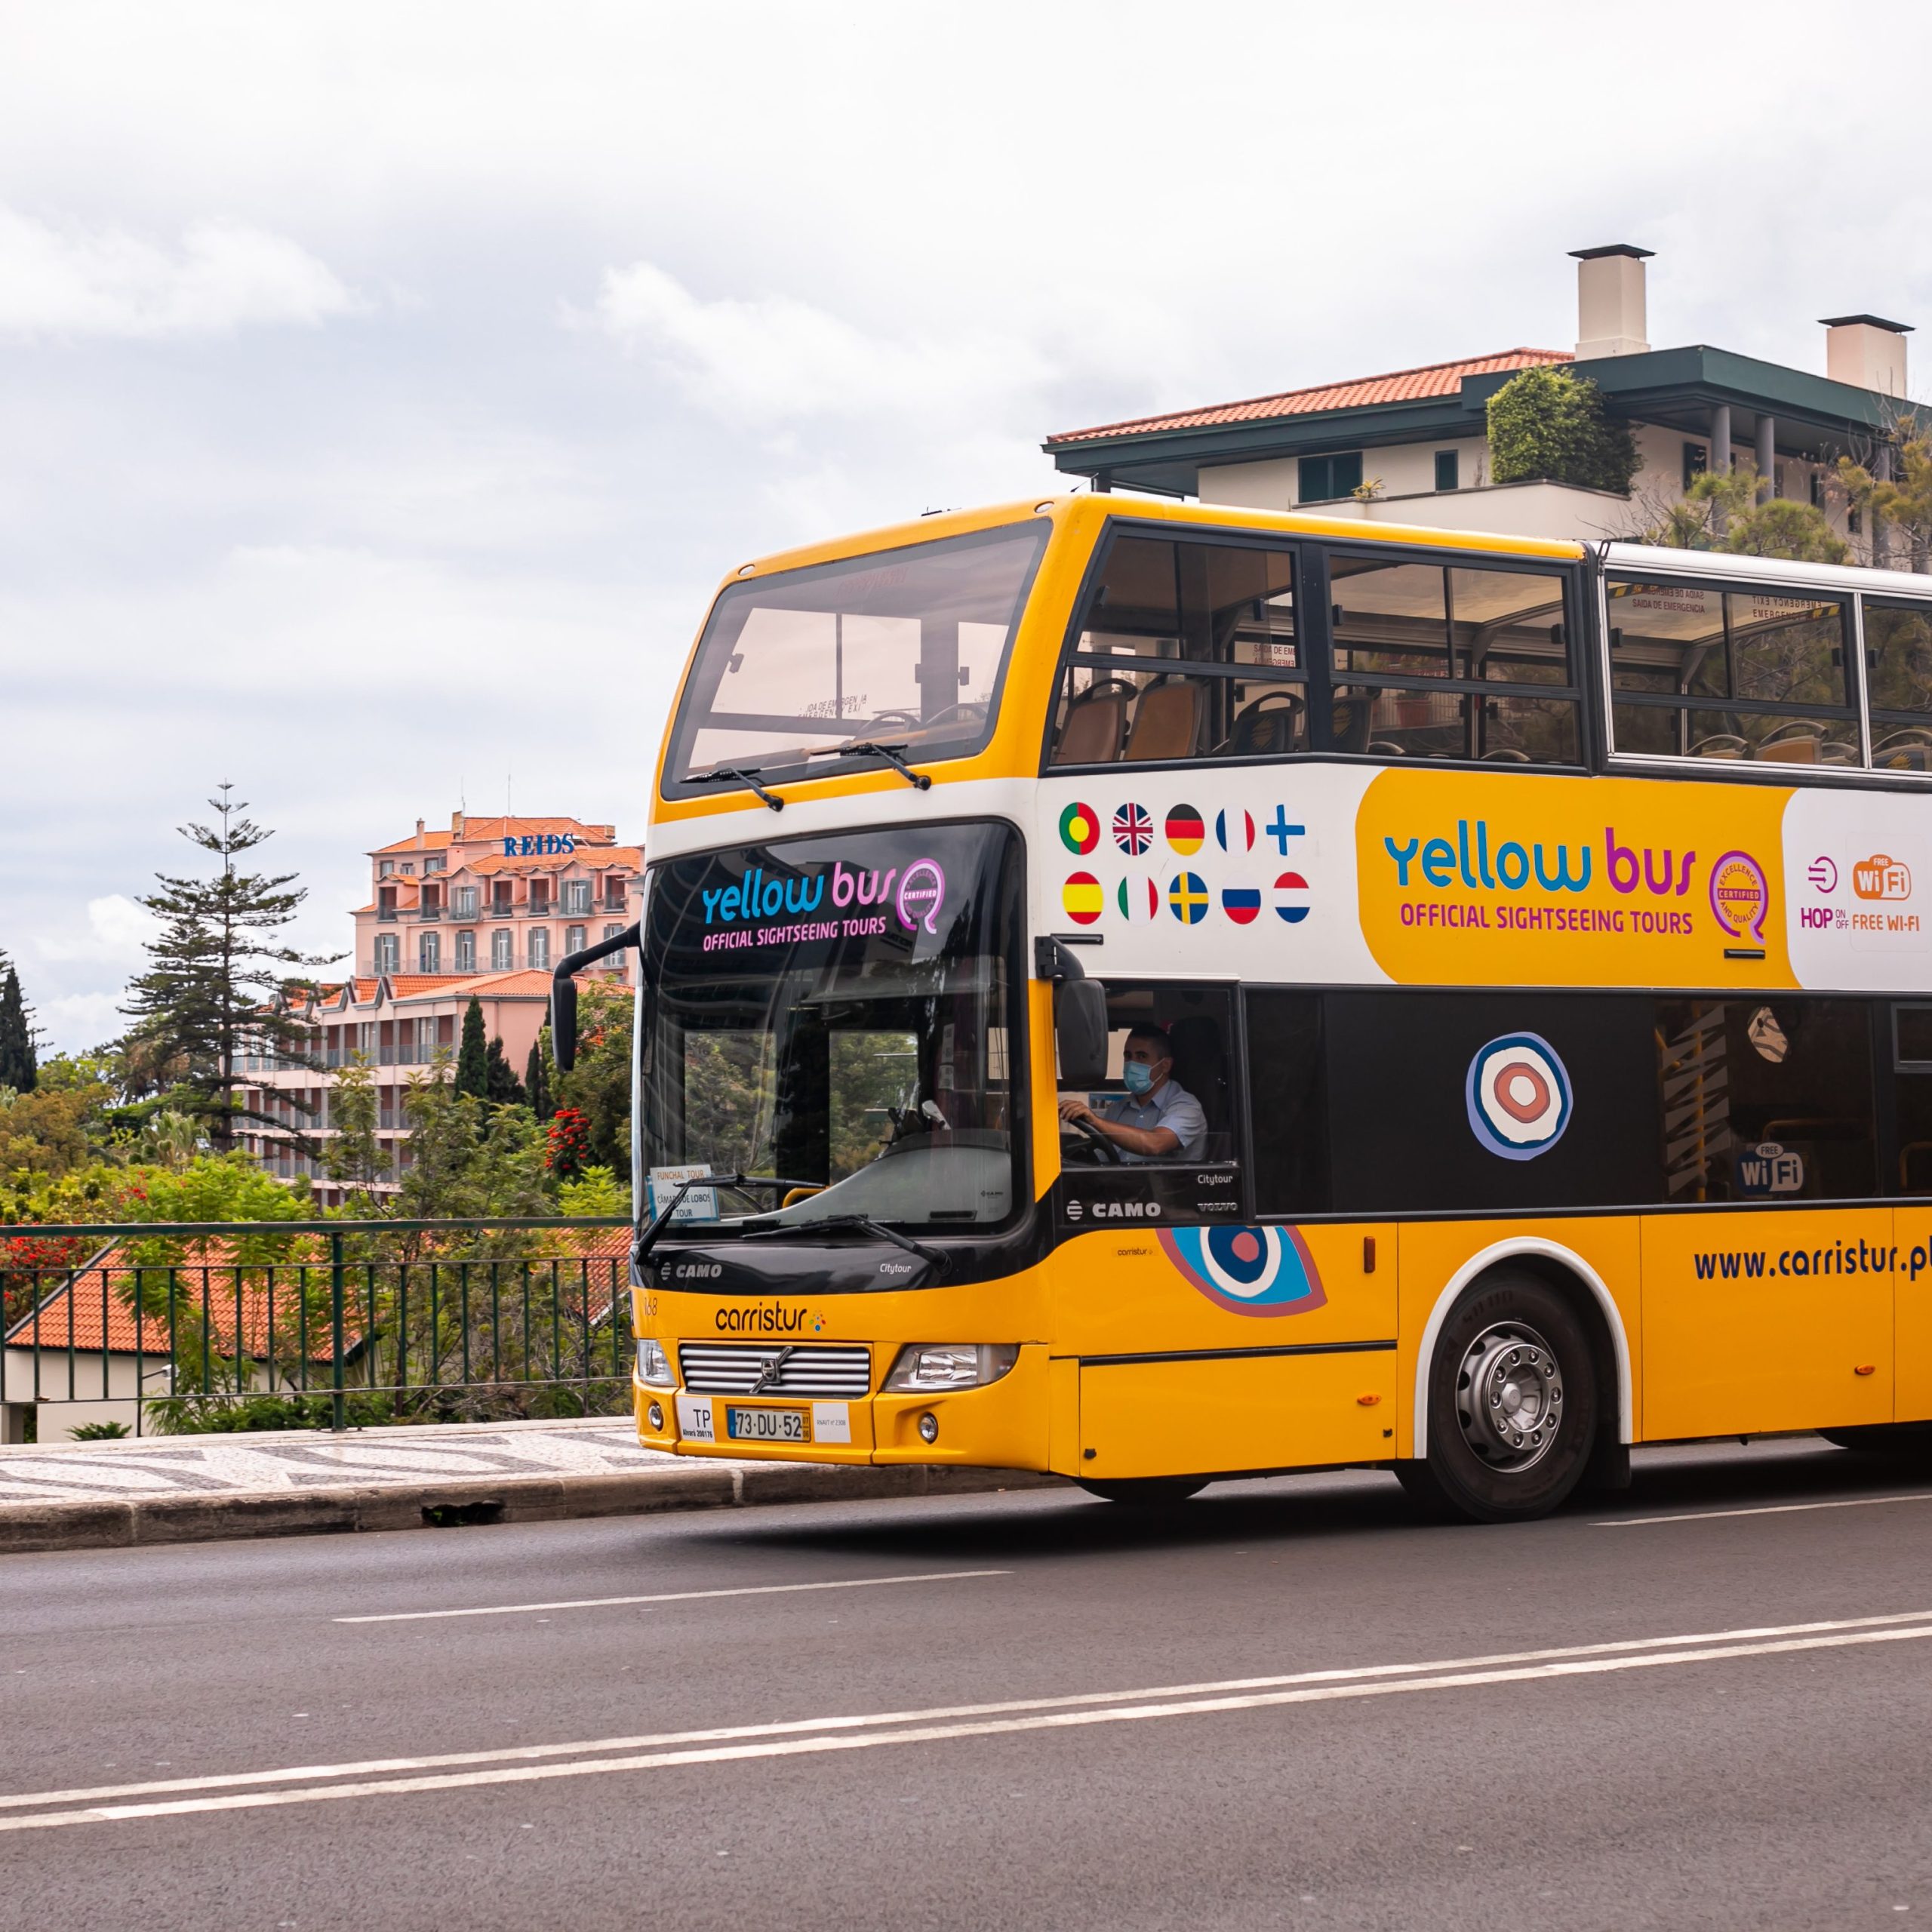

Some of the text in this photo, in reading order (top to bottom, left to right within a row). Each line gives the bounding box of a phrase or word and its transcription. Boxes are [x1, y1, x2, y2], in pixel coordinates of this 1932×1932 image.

[1632, 598, 1653, 608] SAIDA
[1654, 601, 1662, 609] DE
[1273, 646, 1282, 654] DE
[504, 833, 574, 857] REIDS
[1605, 827, 1696, 896] bus
[1873, 858, 1889, 866] FREE
[1719, 863, 1758, 887] EXCELLENCE
[832, 862, 897, 908] bus
[904, 890, 937, 900] CERTIFIED
[1718, 891, 1759, 900] CERTIFIED
[1720, 902, 1758, 923] AND QUALITY
[1801, 907, 1833, 929] HOP
[1835, 909, 1846, 919] ON
[1401, 903, 1694, 935] OFFICIAL SIGHTSEEING TOURS
[1836, 919, 1849, 929] OFF
[1853, 914, 1920, 931] FREE WI-FI
[703, 916, 886, 952] OFFICIAL SIGHTSEEING TOURS
[1761, 1146, 1779, 1155] FREE
[657, 1170, 705, 1180] FUNCHAL TOUR
[1197, 1174, 1233, 1186] Citytour
[691, 1194, 711, 1203] LOBOS
[676, 1209, 693, 1217] TOUR
[1092, 1202, 1161, 1217] CAMO
[1197, 1202, 1238, 1212] VOLVO
[1117, 1247, 1148, 1257] carristur
[676, 1264, 722, 1278] CAMO
[880, 1263, 912, 1275] Citytour
[645, 1297, 657, 1315] 168
[715, 1300, 808, 1331] carristur
[693, 1409, 711, 1428] TP
